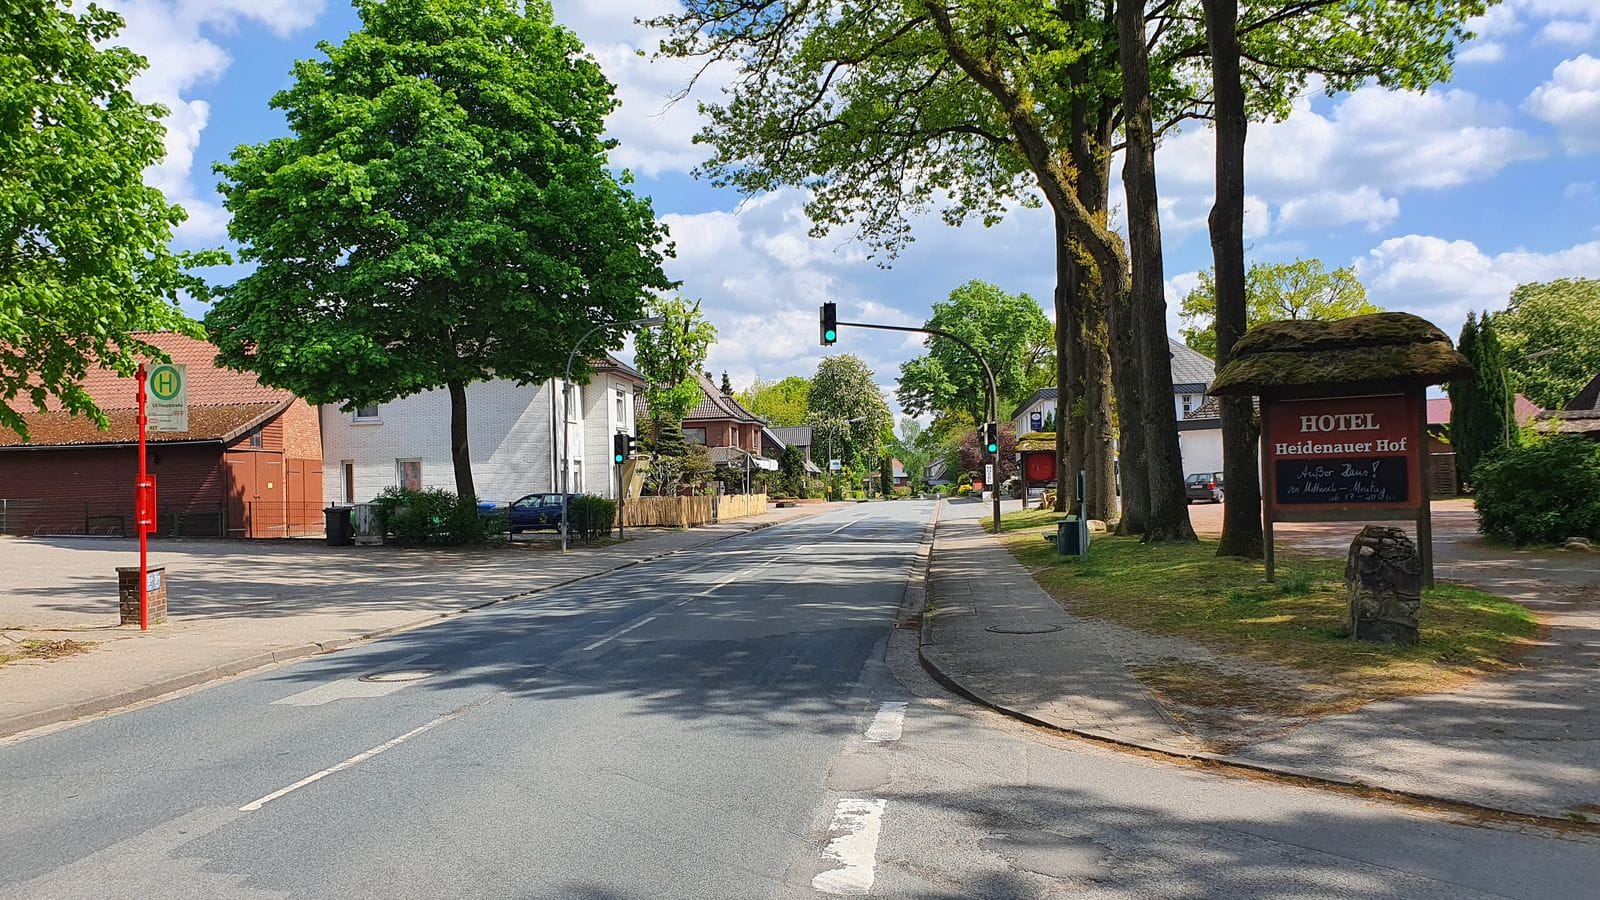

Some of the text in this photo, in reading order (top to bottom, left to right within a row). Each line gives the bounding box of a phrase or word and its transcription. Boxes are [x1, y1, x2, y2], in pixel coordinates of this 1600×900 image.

[159, 373, 172, 393] H
[1299, 413, 1380, 433] HOTEL
[1274, 437, 1407, 456] Heidenauer Hof
